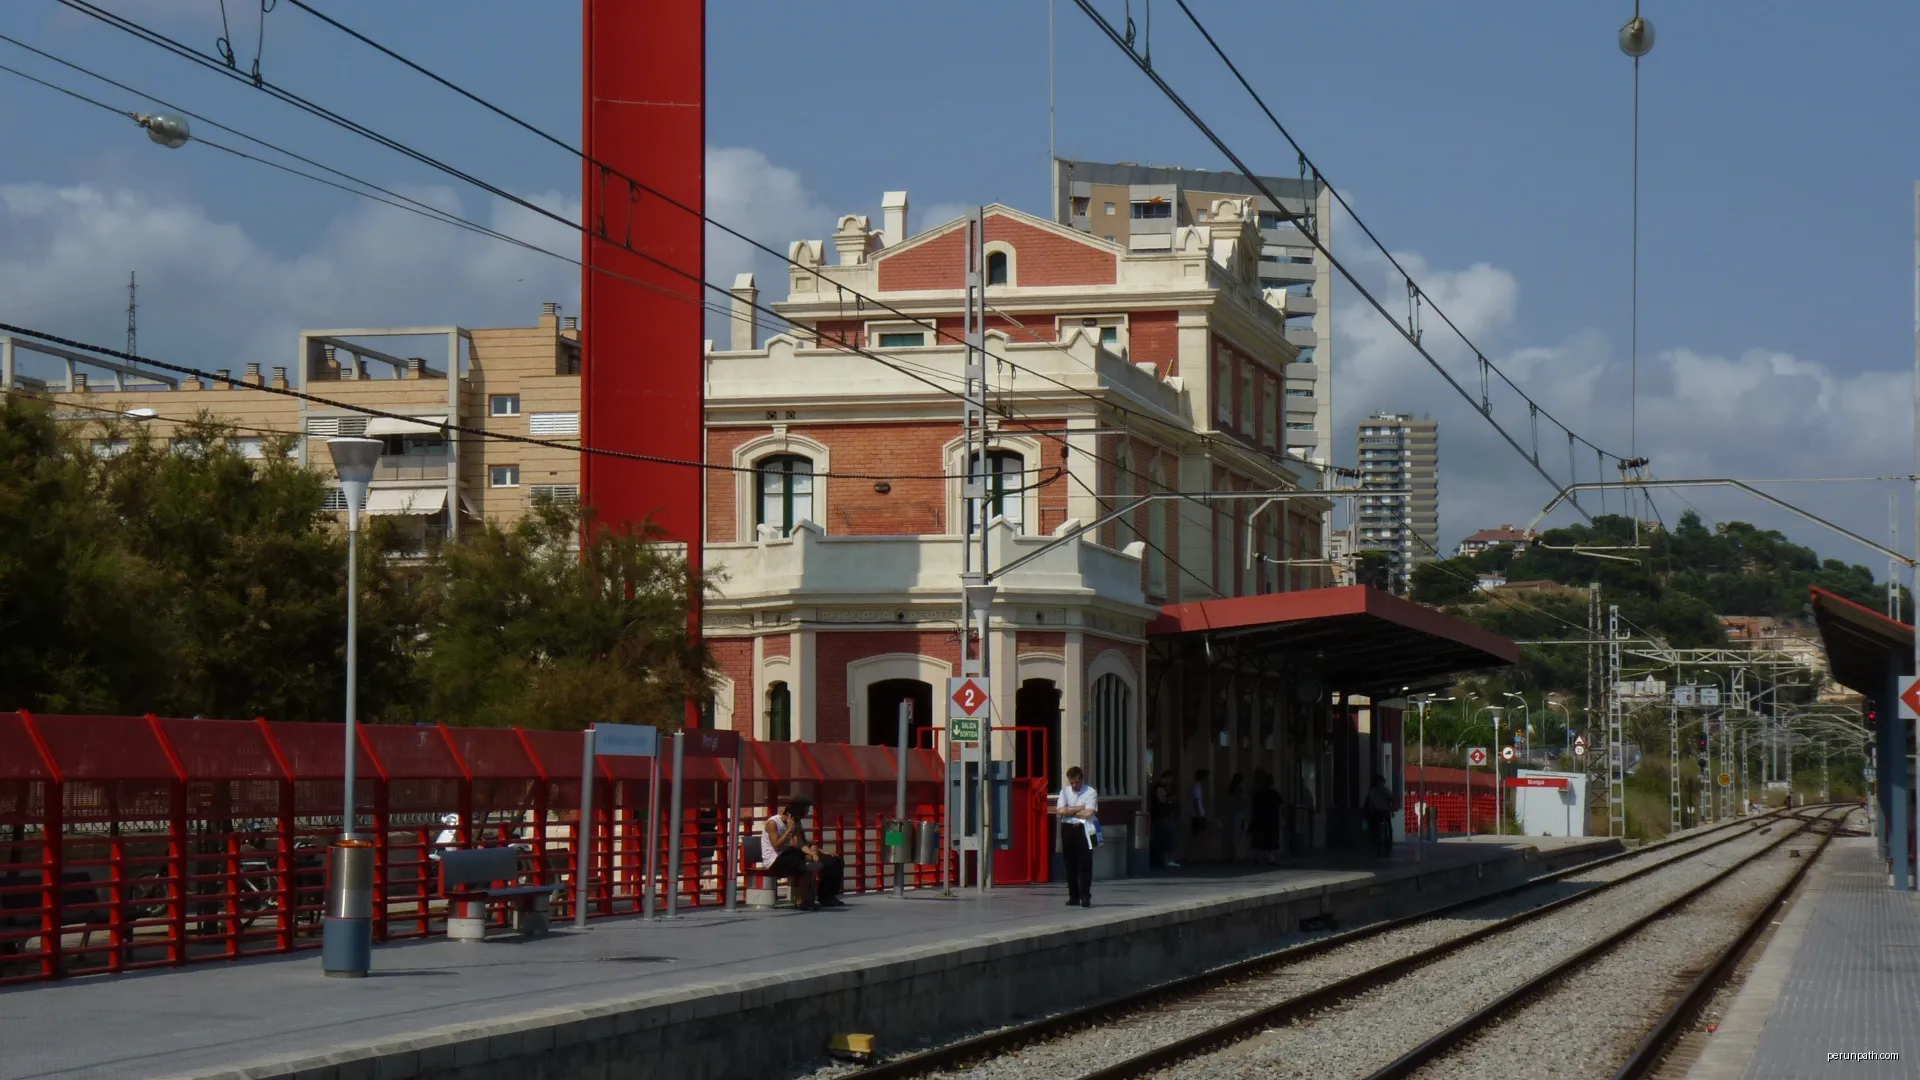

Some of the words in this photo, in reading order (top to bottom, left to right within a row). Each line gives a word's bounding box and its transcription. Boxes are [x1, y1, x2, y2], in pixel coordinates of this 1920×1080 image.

[965, 689, 975, 707] 2
[961, 721, 977, 729] SALIDA
[960, 730, 978, 738] SORTIDA
[1474, 753, 1480, 761] 2
